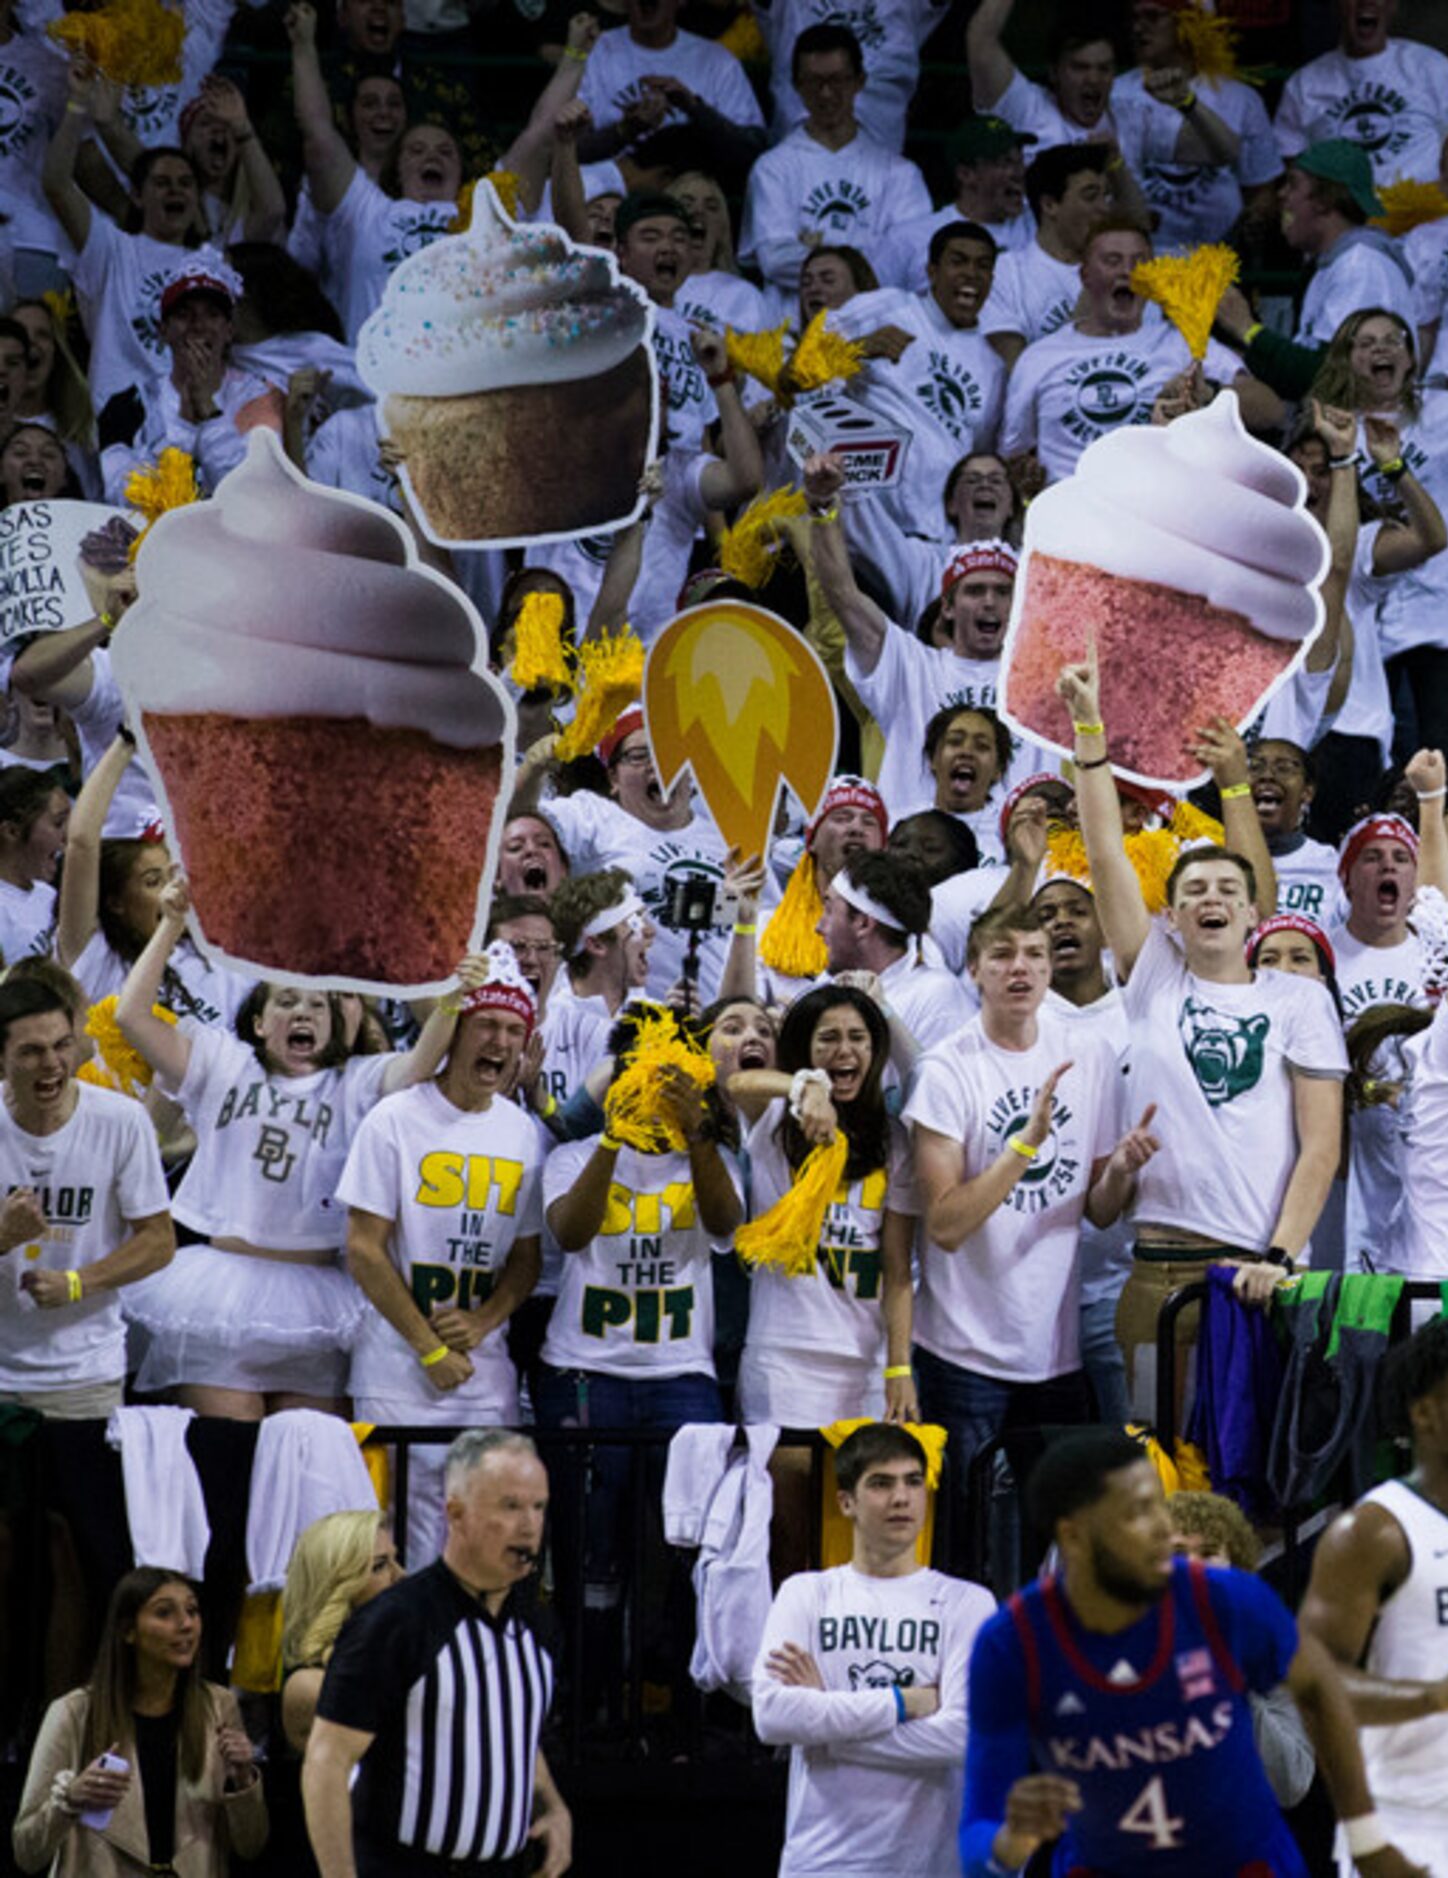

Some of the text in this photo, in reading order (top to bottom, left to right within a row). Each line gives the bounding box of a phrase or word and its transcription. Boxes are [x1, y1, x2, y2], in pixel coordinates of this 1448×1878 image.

[986, 1086, 1073, 1134] LIVE FOM
[415, 1150, 524, 1217] SIT
[460, 1213, 486, 1237] IN
[599, 1180, 697, 1236] SIT
[447, 1238, 493, 1266] THE
[628, 1237, 663, 1261] IN
[615, 1262, 675, 1286] THE
[581, 1283, 695, 1344] PIT
[819, 1616, 941, 1656] BAYLOR
[1047, 1703, 1234, 1771] KANSAS
[1117, 1774, 1186, 1850] 4
